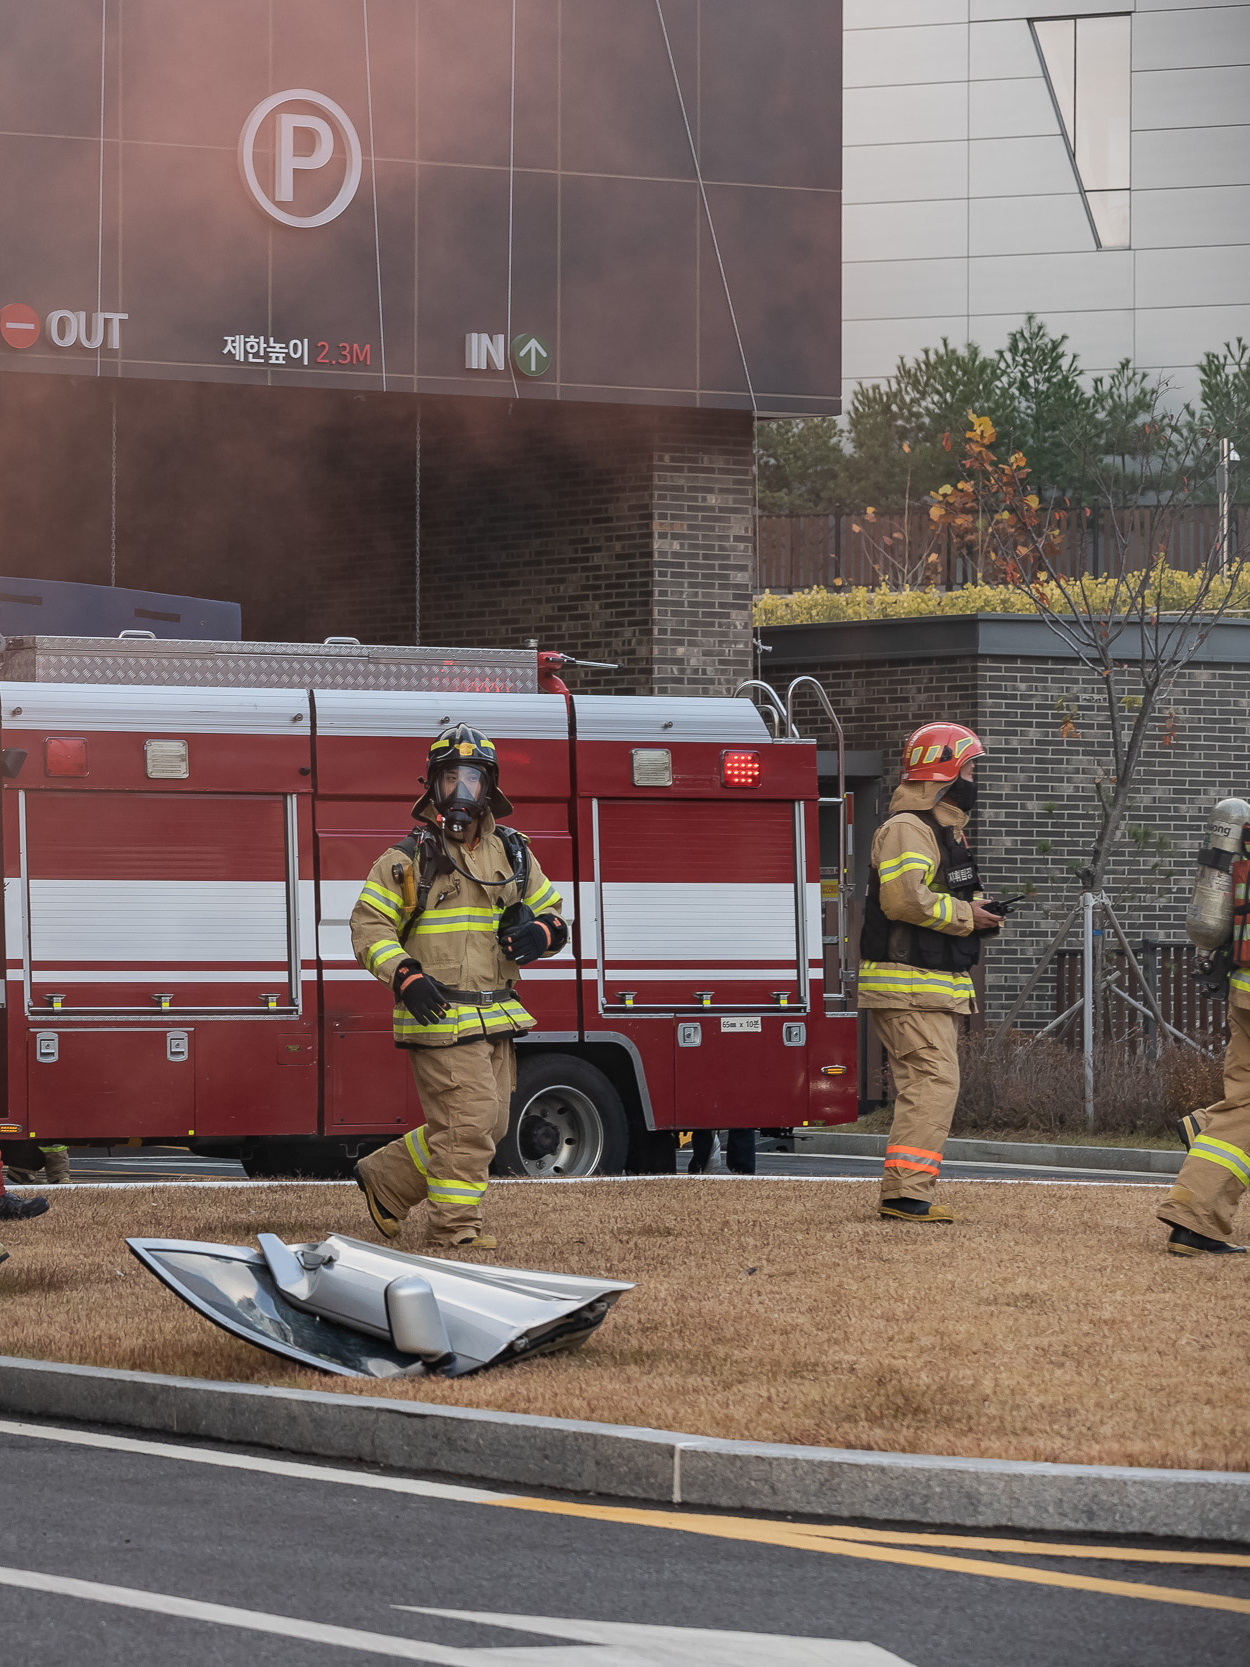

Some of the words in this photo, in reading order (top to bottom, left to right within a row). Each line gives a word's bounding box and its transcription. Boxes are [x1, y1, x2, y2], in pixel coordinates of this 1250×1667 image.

[275, 113, 334, 202] P
[45, 308, 129, 351] OUT
[222, 333, 310, 367] 제한높이
[316, 341, 372, 367] 2.3M
[465, 332, 505, 372] IN
